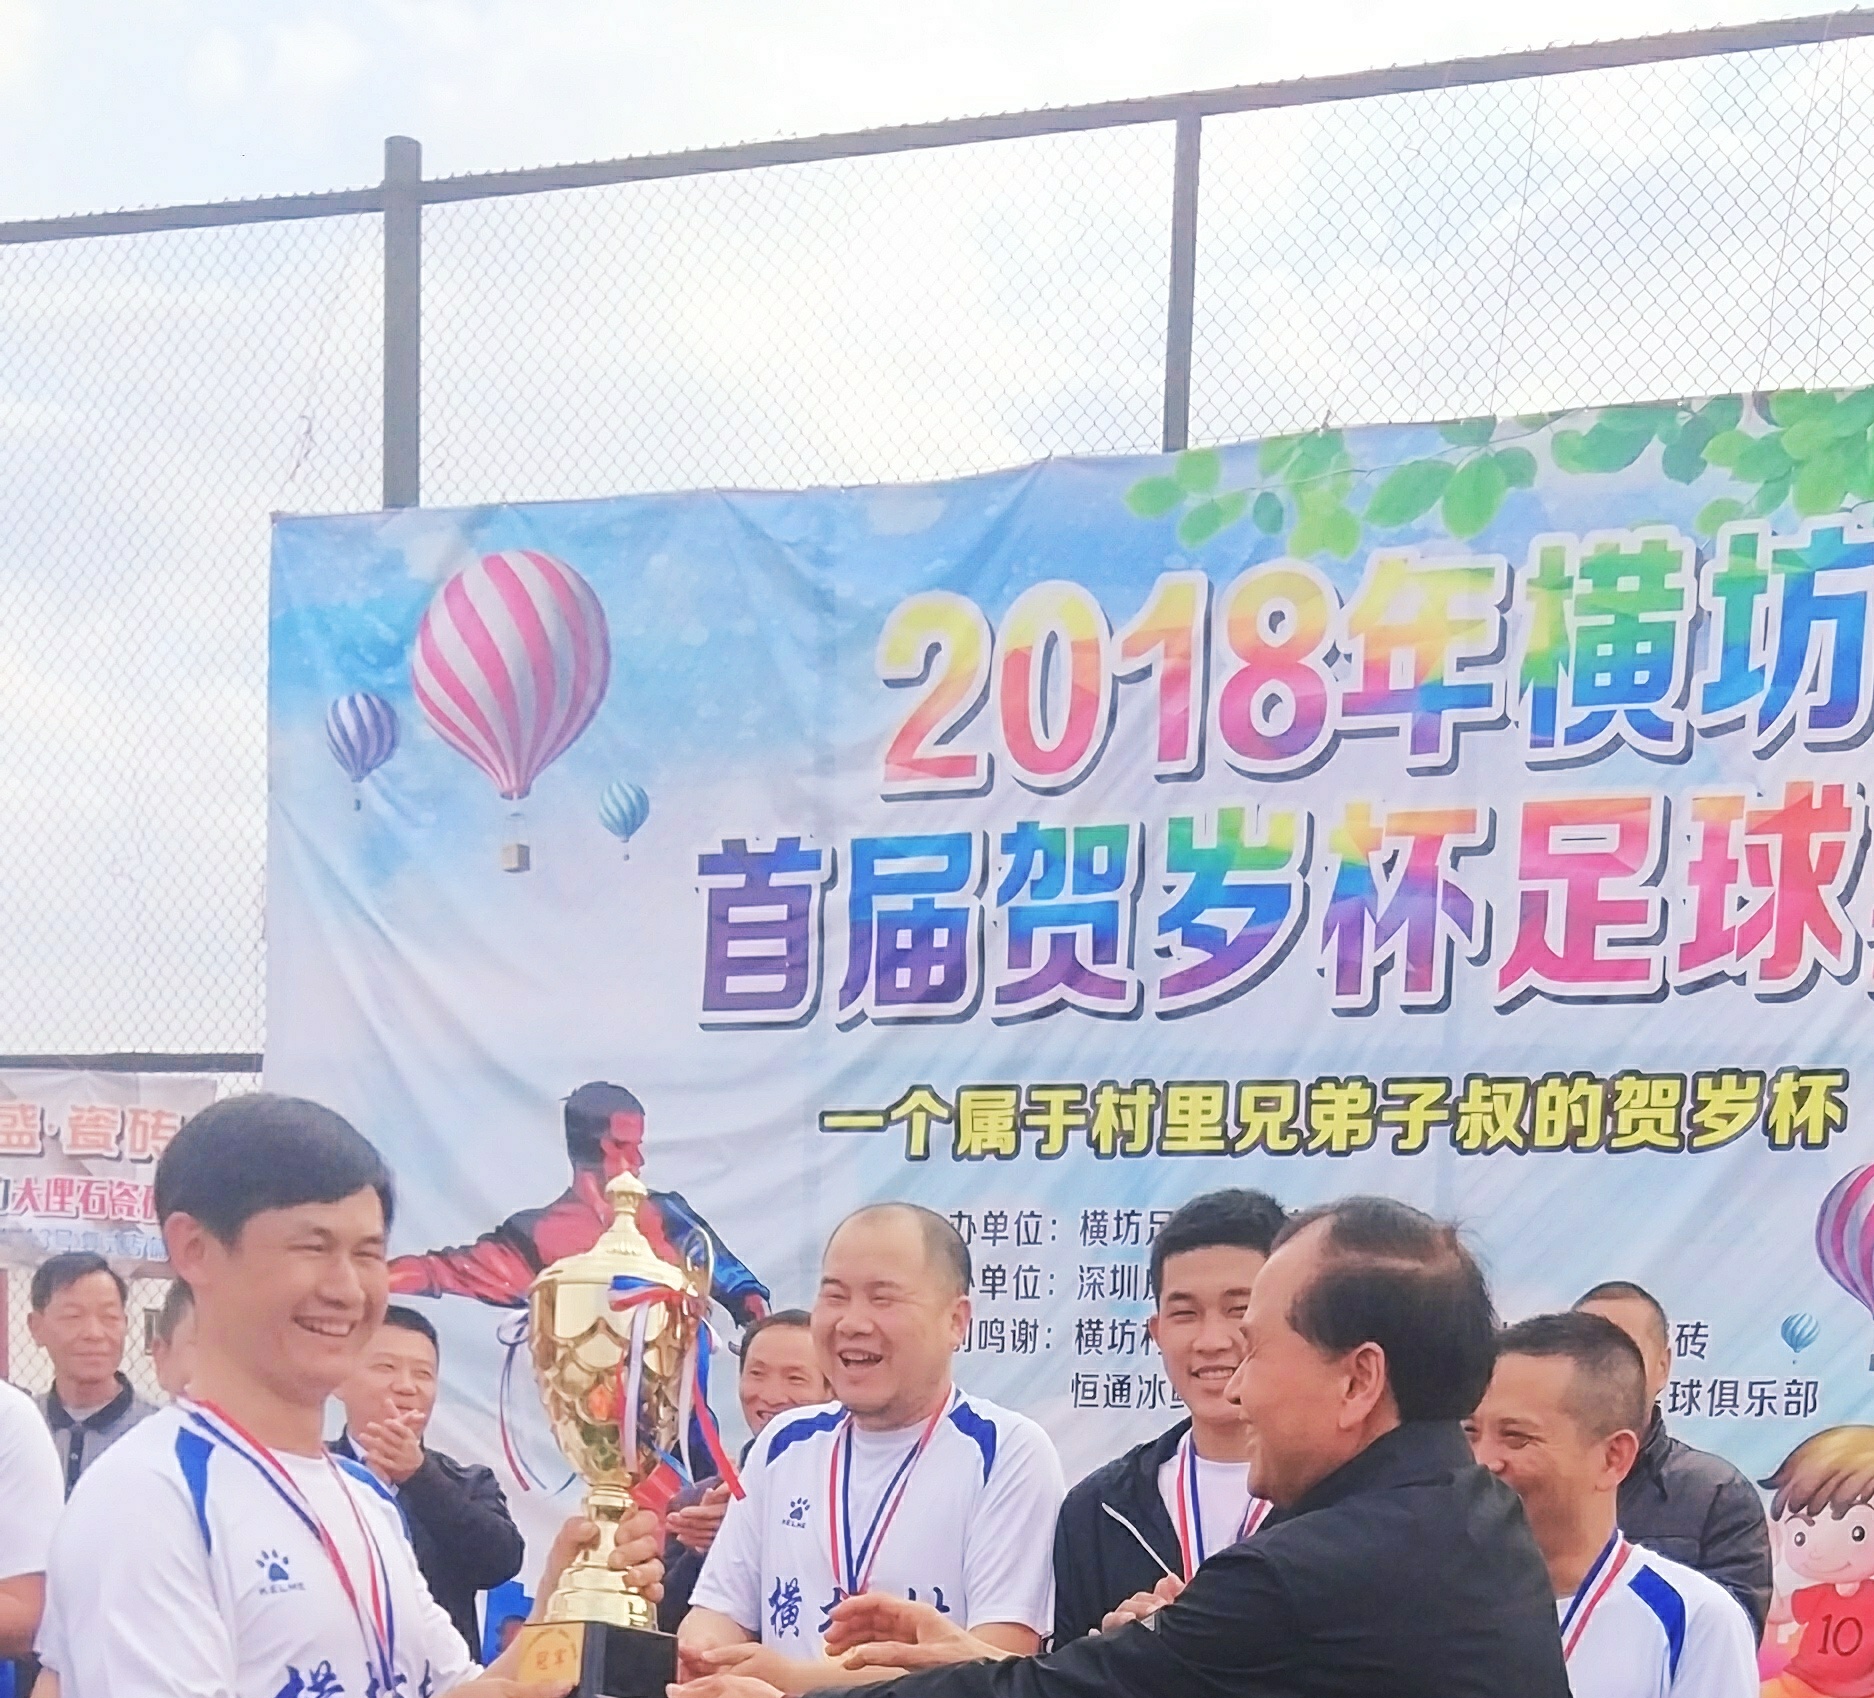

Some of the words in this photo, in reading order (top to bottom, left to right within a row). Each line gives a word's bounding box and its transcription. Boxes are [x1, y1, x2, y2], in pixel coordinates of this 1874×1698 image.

[876, 522, 1874, 797] 2018年横坊
[697, 779, 1874, 1030] 首届贺岁杯足球
[819, 1067, 1850, 1160] 一个属于村里兄弟子叔的贺岁杯
[0, 1177, 158, 1220] 大理石瓷
[969, 1263, 1157, 1302] 单位：深圳
[1674, 1321, 1710, 1360] 砖
[1667, 1378, 1820, 1419] 球俱乐部
[1817, 1613, 1863, 1657] 10
